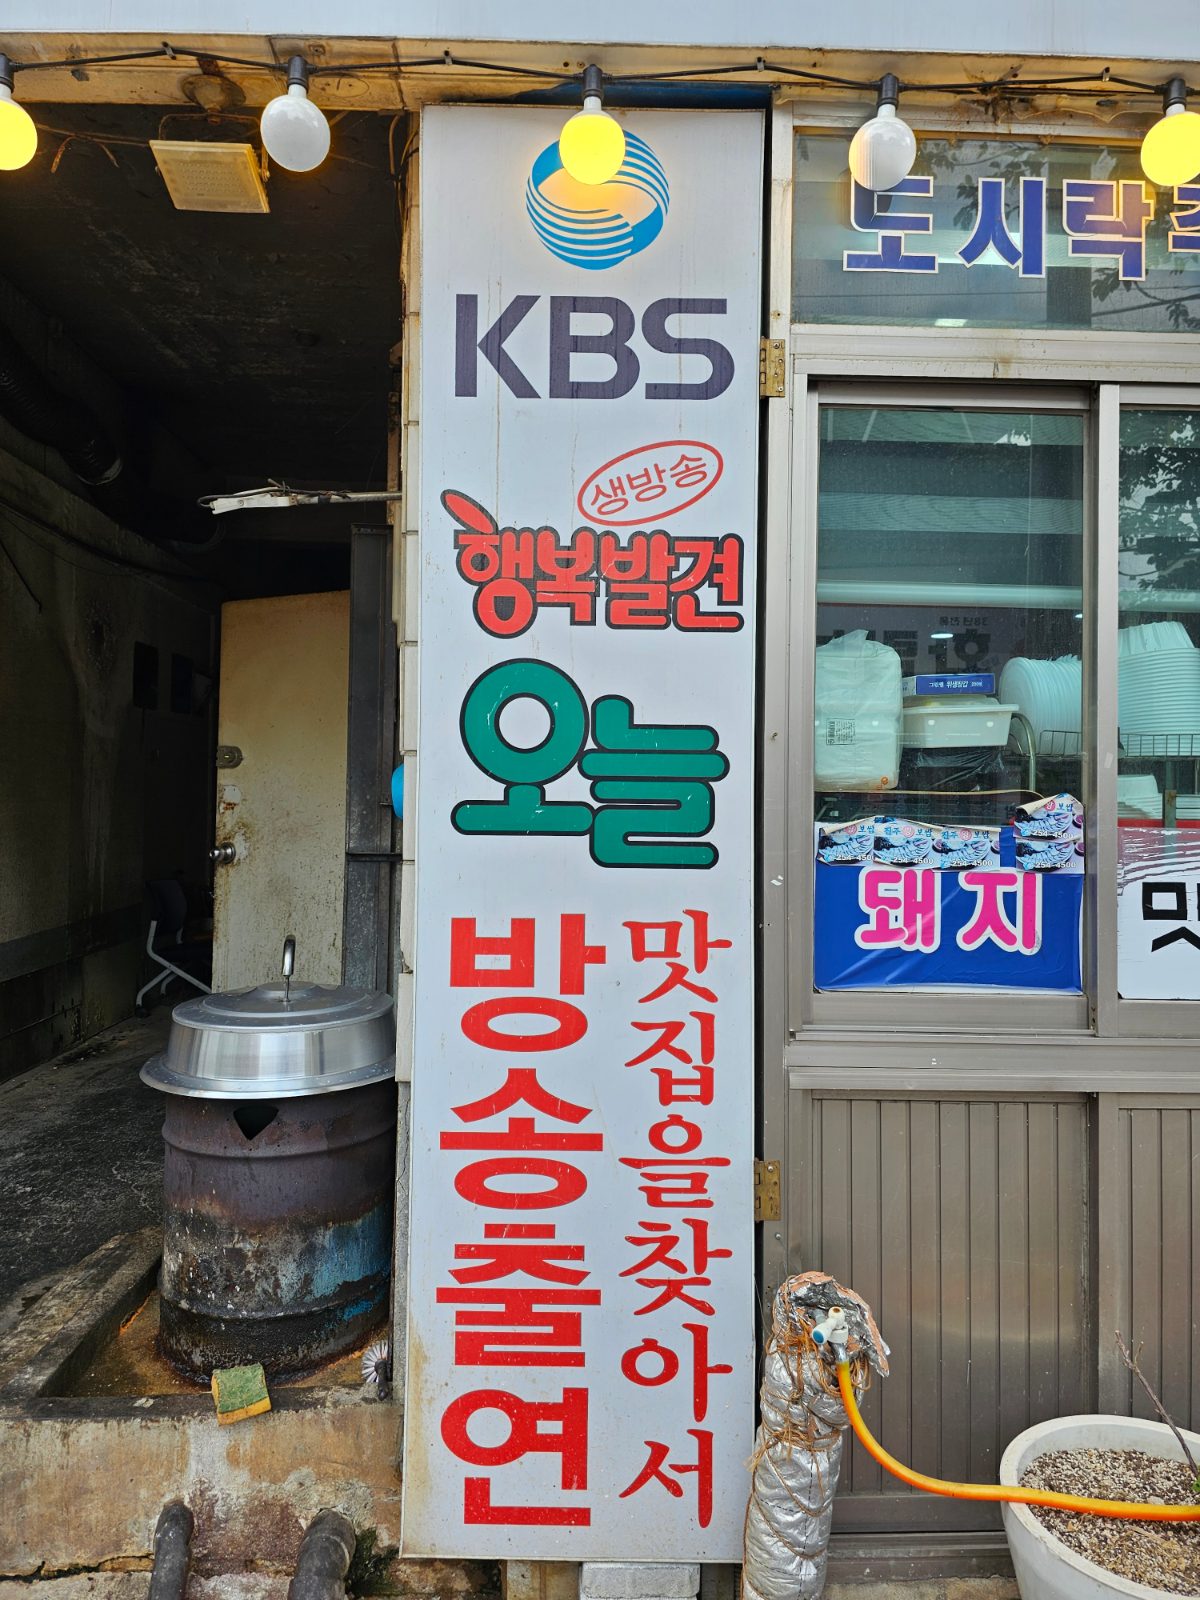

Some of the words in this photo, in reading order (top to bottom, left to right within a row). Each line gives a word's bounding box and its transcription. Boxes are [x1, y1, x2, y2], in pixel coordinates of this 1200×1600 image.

[455, 293, 735, 400] KBS
[591, 454, 707, 515] 생방송
[441, 489, 745, 639] 행복발견
[451, 657, 731, 870] 오늘
[893, 856, 934, 865] 254-4500
[952, 859, 993, 867] 254-4500
[1035, 861, 1077, 869] 254-4500
[855, 865, 1043, 956] 돼지
